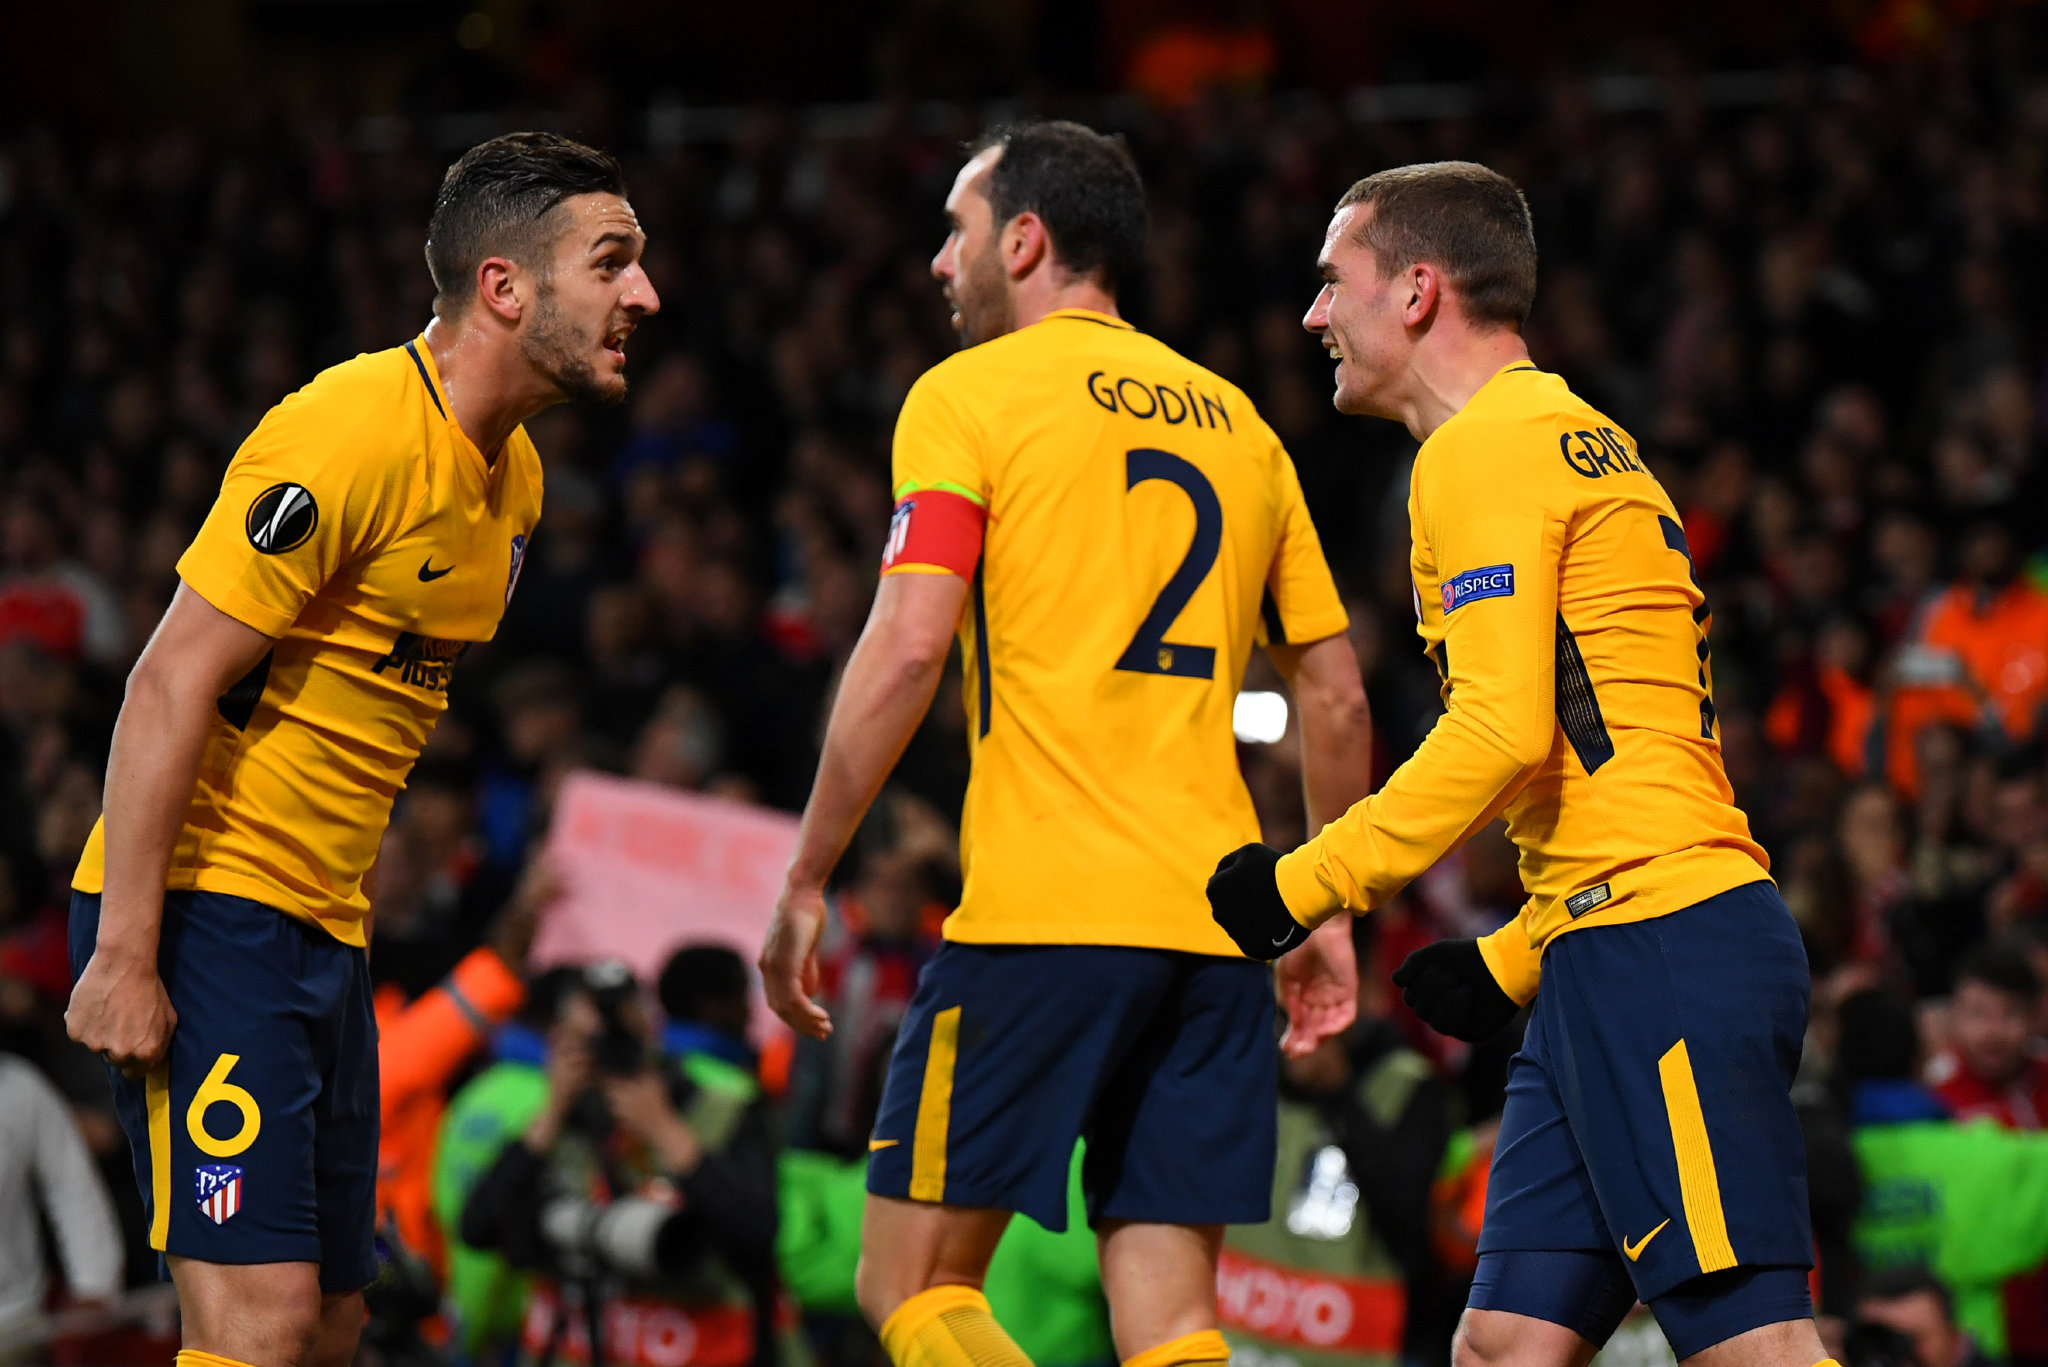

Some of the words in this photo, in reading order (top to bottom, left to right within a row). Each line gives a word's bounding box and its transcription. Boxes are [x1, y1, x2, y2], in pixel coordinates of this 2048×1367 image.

[1560, 427, 1647, 479] GRIE
[1114, 448, 1223, 680] 2
[1455, 573, 1512, 599] RESPECT
[186, 1052, 262, 1158] 6
